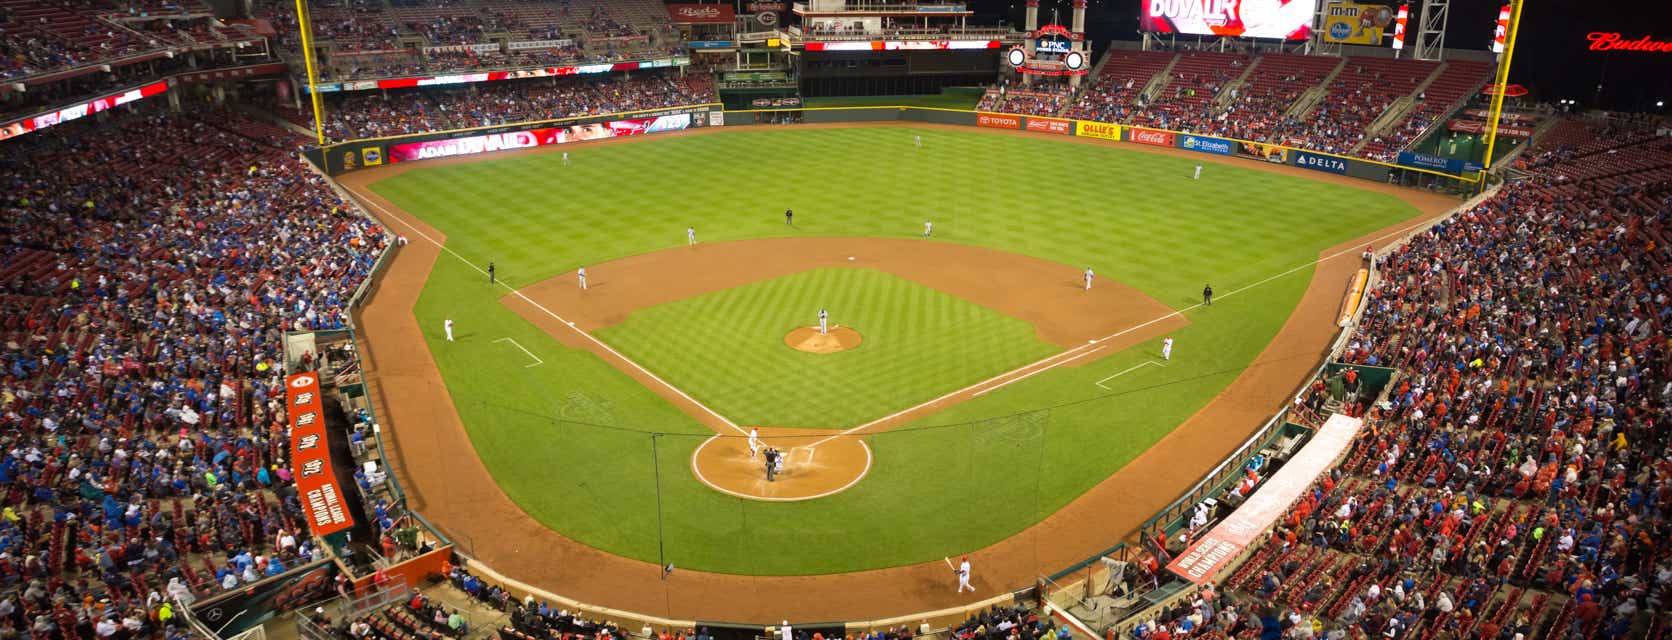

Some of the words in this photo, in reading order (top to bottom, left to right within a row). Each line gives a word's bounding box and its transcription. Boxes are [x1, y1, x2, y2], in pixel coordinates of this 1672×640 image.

[1048, 41, 1065, 49] PNC
[991, 117, 1017, 126] TOYOTA
[418, 144, 456, 159] ADAM
[1308, 158, 1345, 171] DELTA
[307, 489, 332, 526] CHAMPIONS
[1187, 540, 1236, 578] CHAMPIONS
